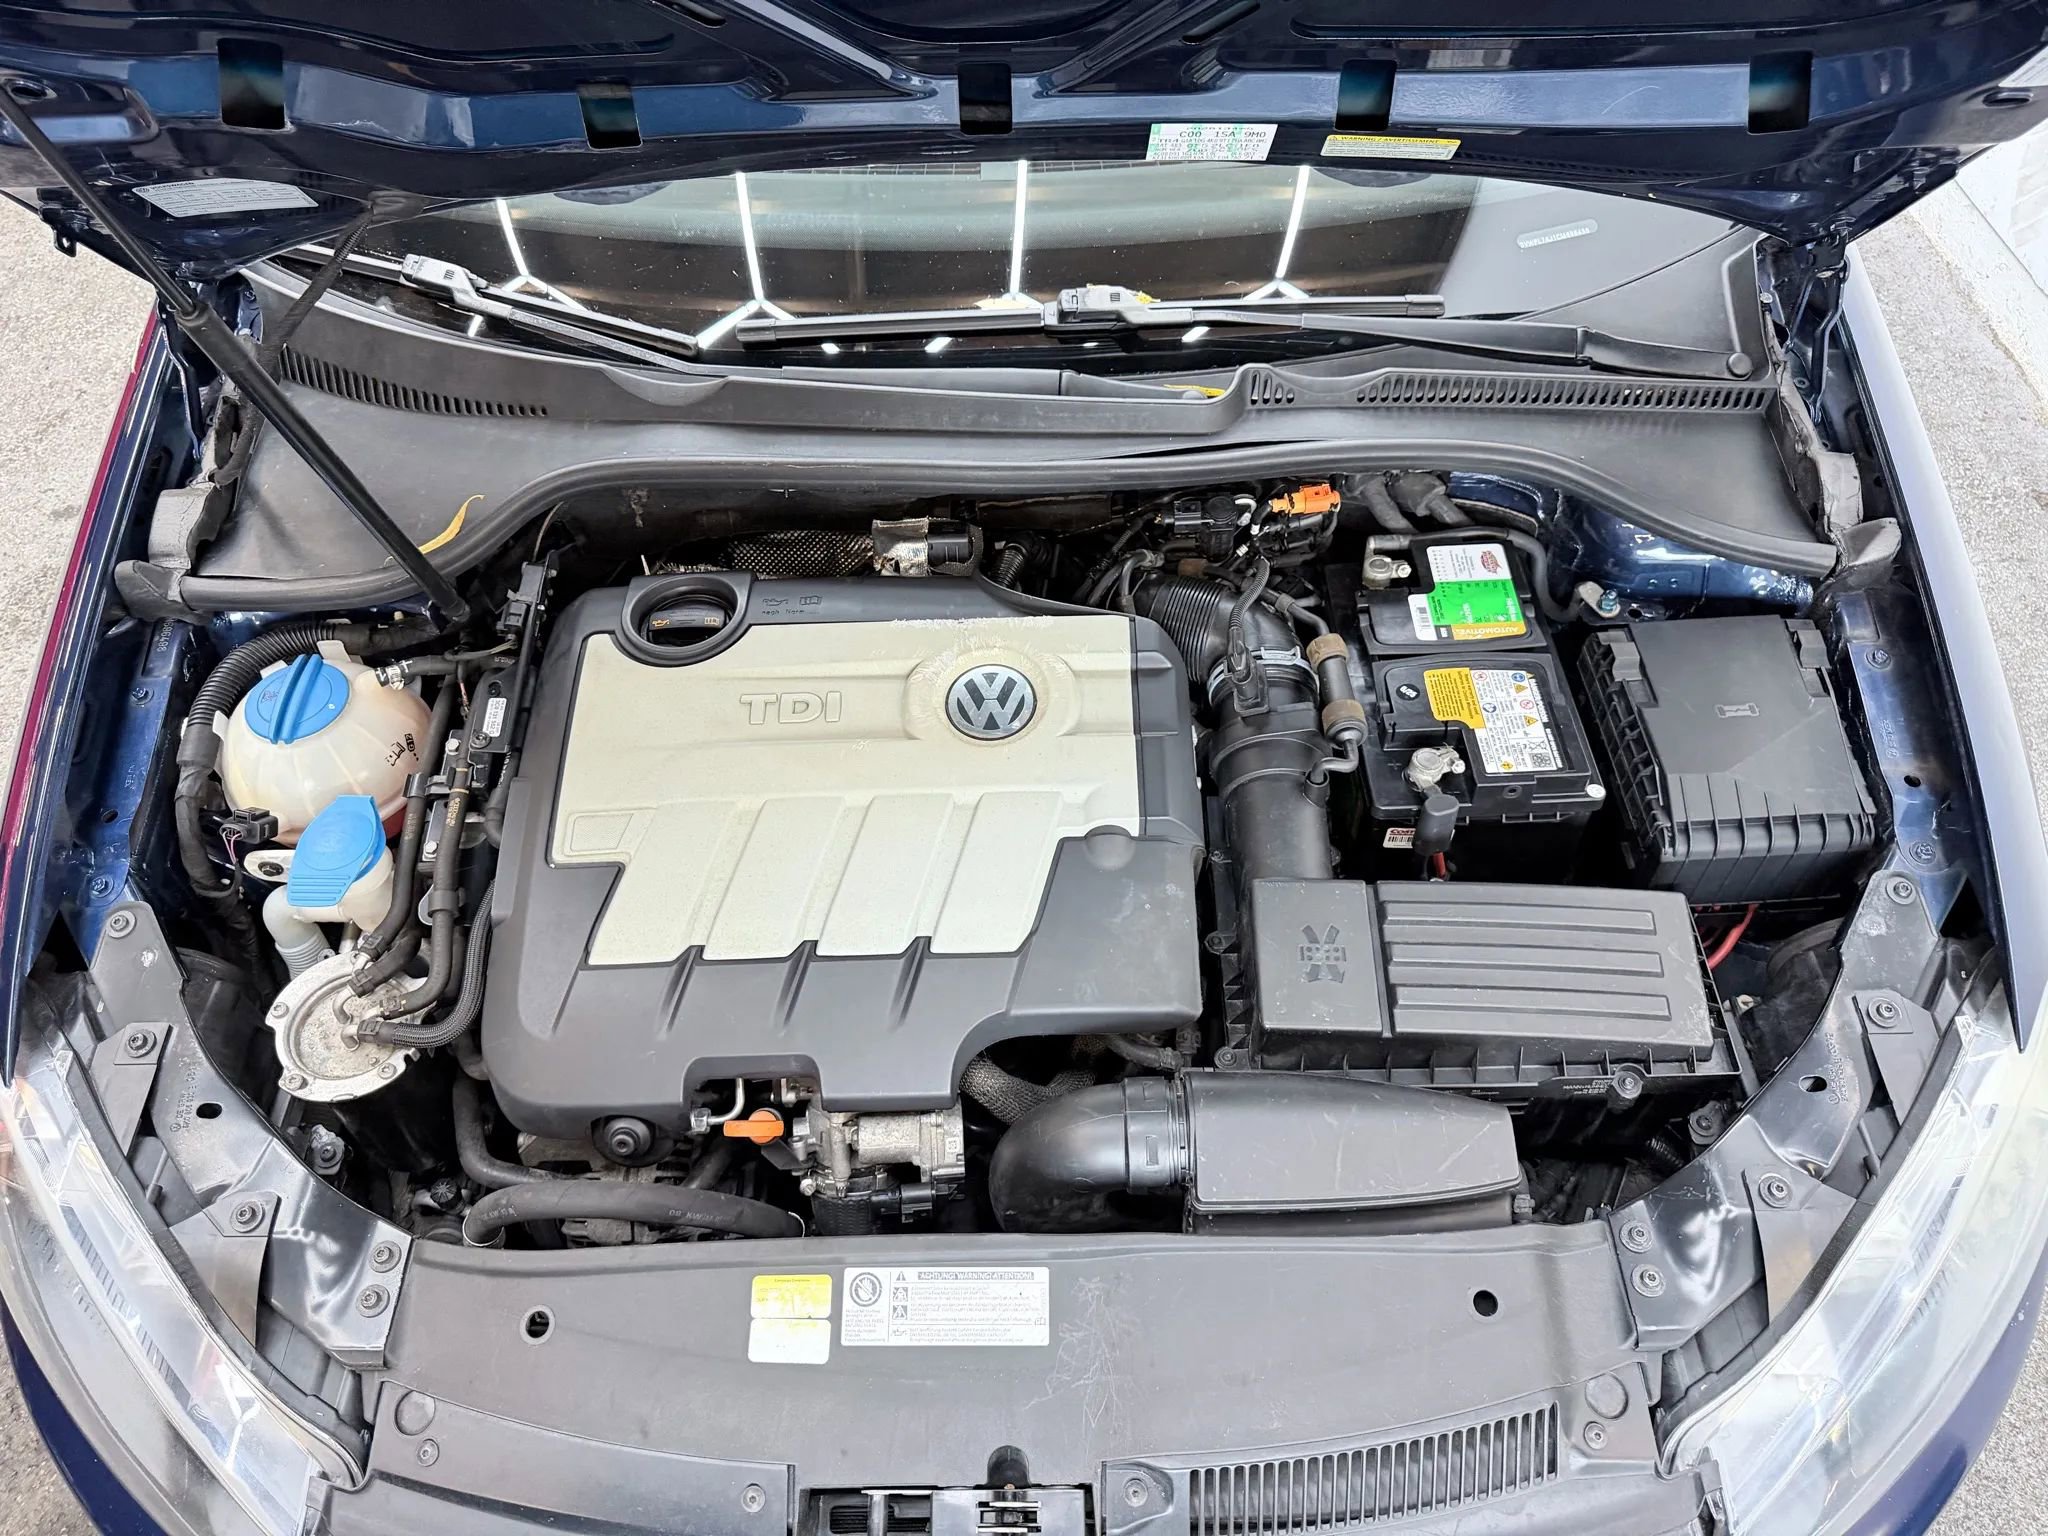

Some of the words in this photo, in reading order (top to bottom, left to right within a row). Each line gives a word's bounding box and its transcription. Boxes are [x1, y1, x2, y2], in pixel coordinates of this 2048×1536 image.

[156, 619, 174, 652] 696498
[1458, 626, 1519, 636] AUTOMOTIVE
[739, 690, 842, 726] TDI
